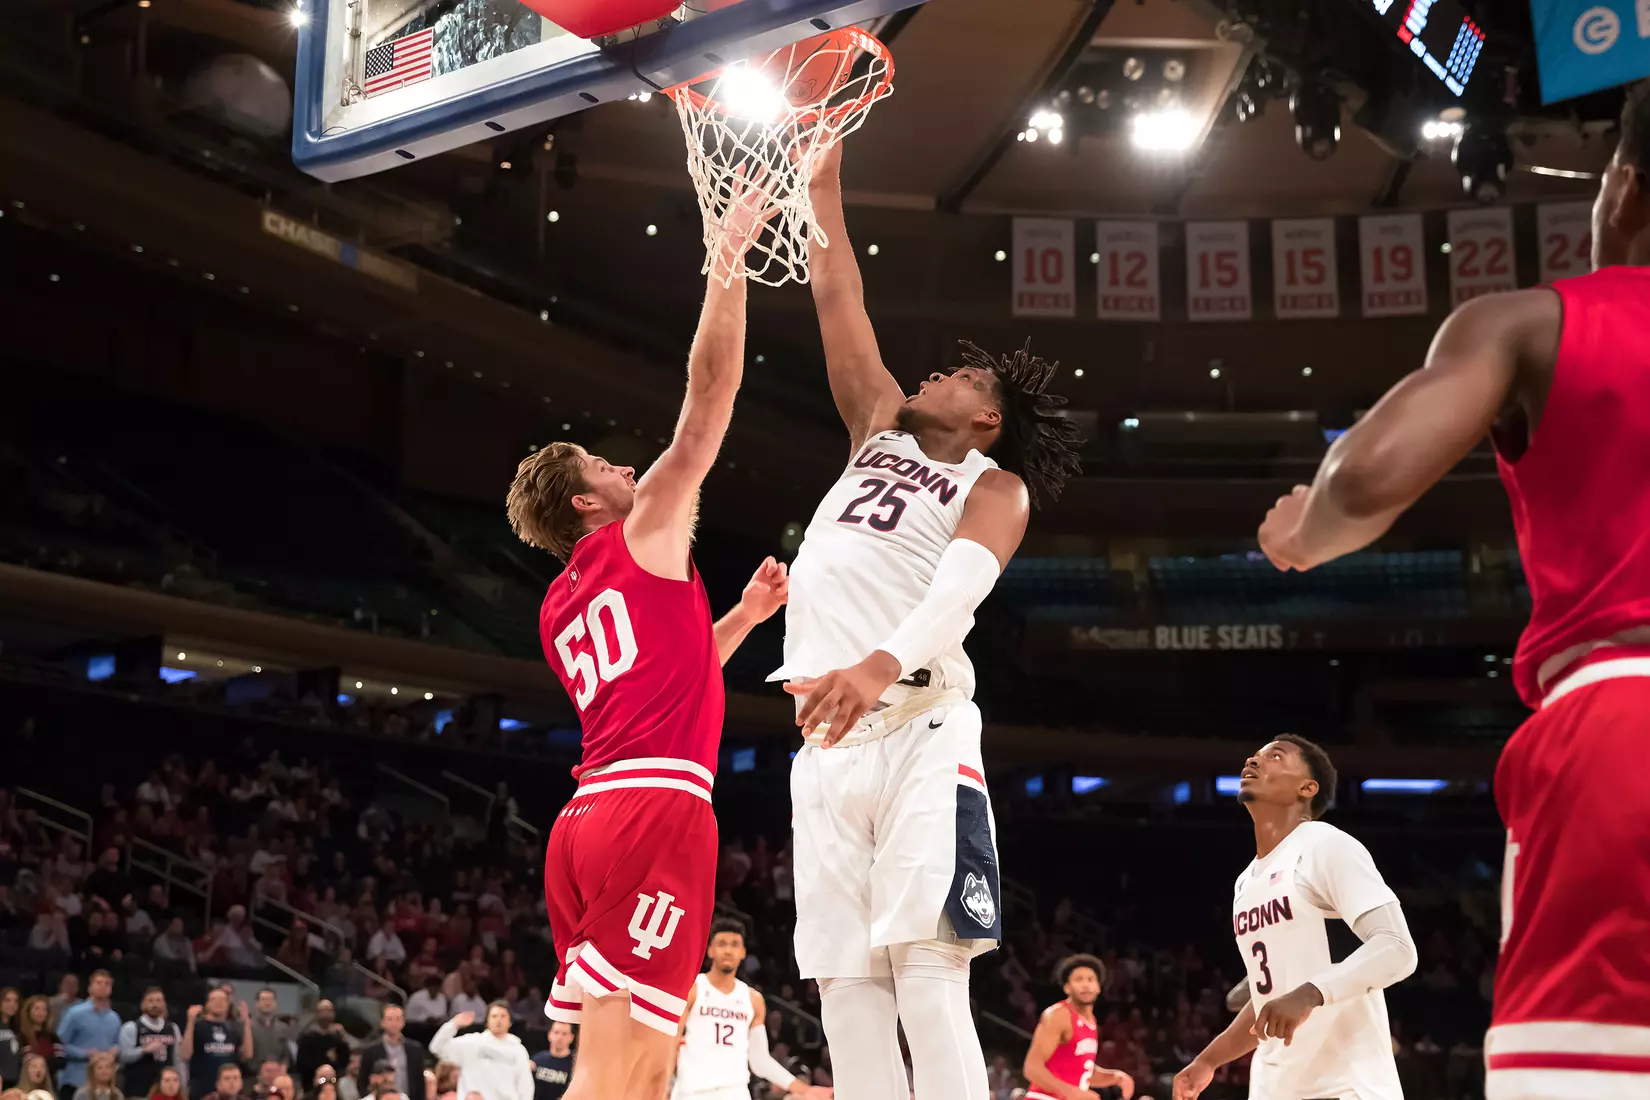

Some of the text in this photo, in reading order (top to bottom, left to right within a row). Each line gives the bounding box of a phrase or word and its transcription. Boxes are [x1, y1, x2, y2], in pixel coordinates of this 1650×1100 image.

[1023, 246, 1065, 285] 10
[1107, 250, 1149, 288] 12
[1198, 250, 1240, 289] 15
[1284, 247, 1327, 287] 15
[1372, 244, 1414, 285] 19
[1456, 237, 1510, 278] 22
[853, 448, 958, 507] UCONN
[836, 478, 922, 532] 25
[554, 587, 639, 712] 50
[1155, 625, 1212, 650] BLUE
[1217, 624, 1283, 649] SEATS
[1233, 895, 1294, 937] CONN
[1251, 940, 1273, 995] 3
[699, 1005, 748, 1021] UCONN
[714, 1022, 735, 1047] 12
